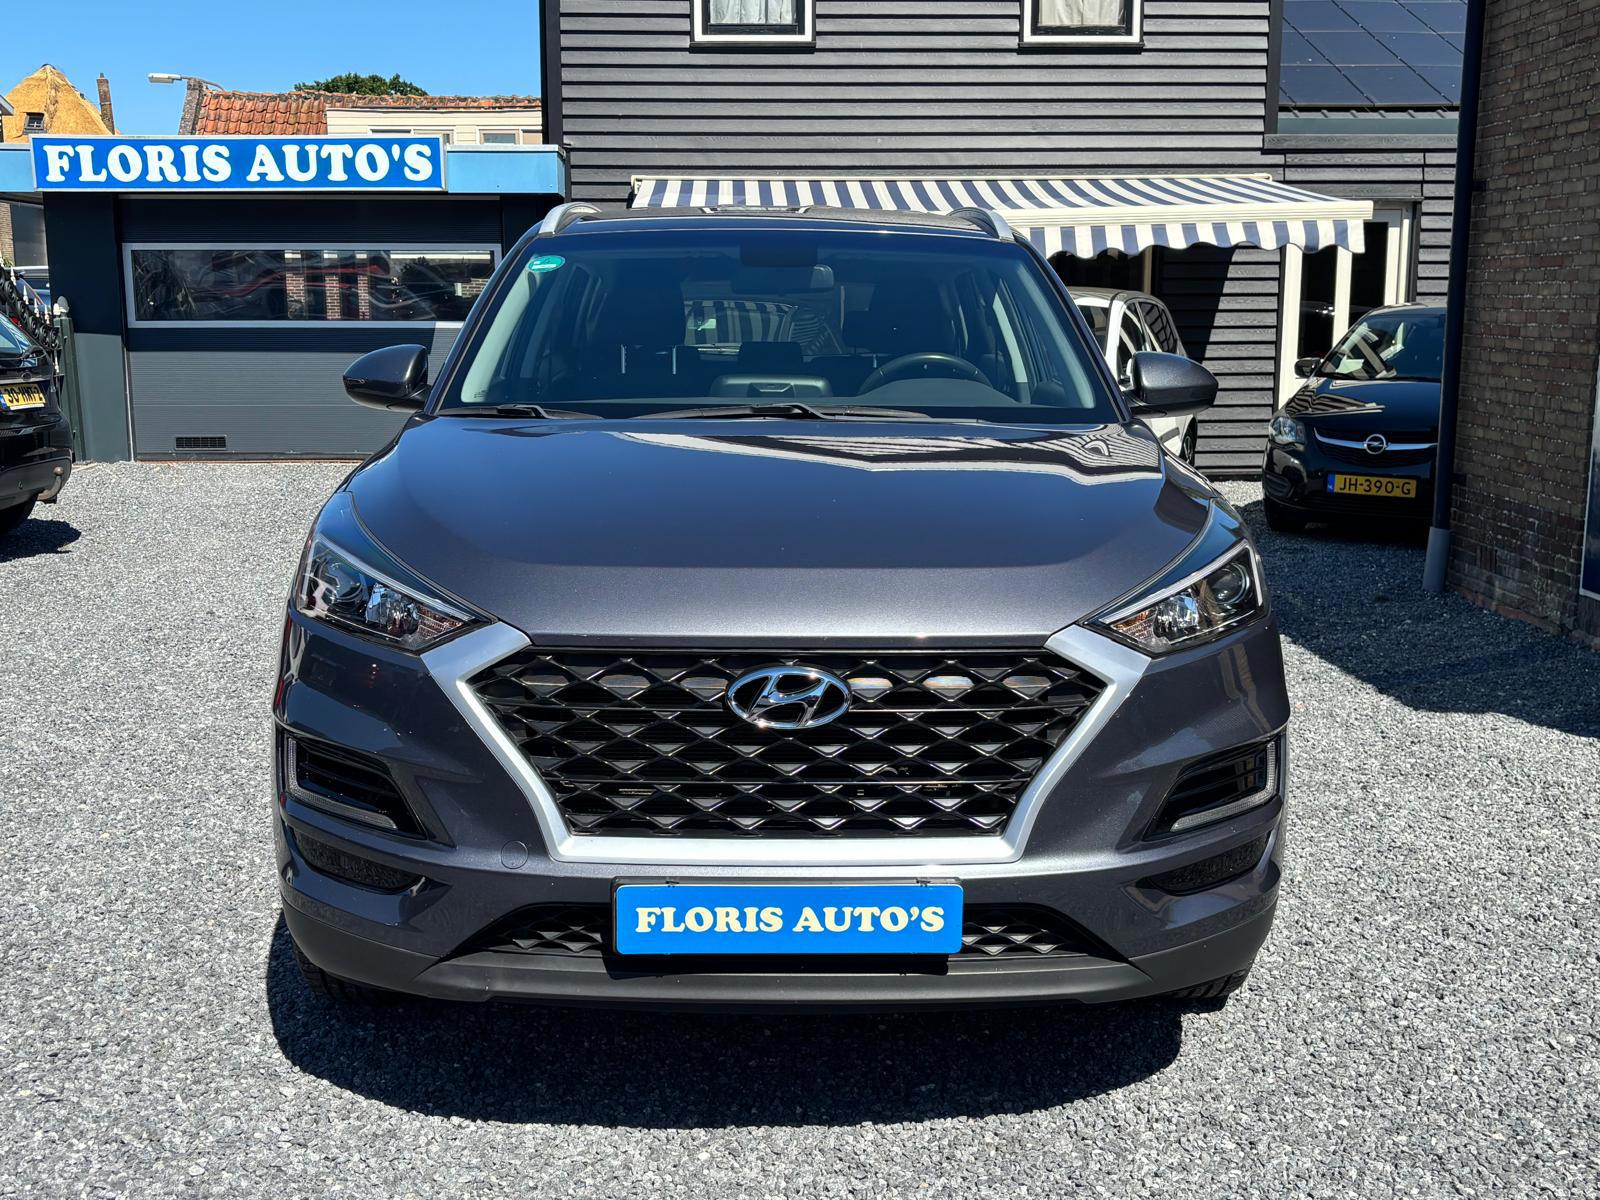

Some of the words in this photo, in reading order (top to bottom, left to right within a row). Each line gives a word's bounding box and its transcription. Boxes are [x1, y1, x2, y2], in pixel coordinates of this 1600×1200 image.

[43, 144, 232, 183] FLORIS
[246, 143, 433, 182] AUTO'S
[1339, 477, 1412, 495] JH-390-G
[635, 906, 784, 933] FLORIS
